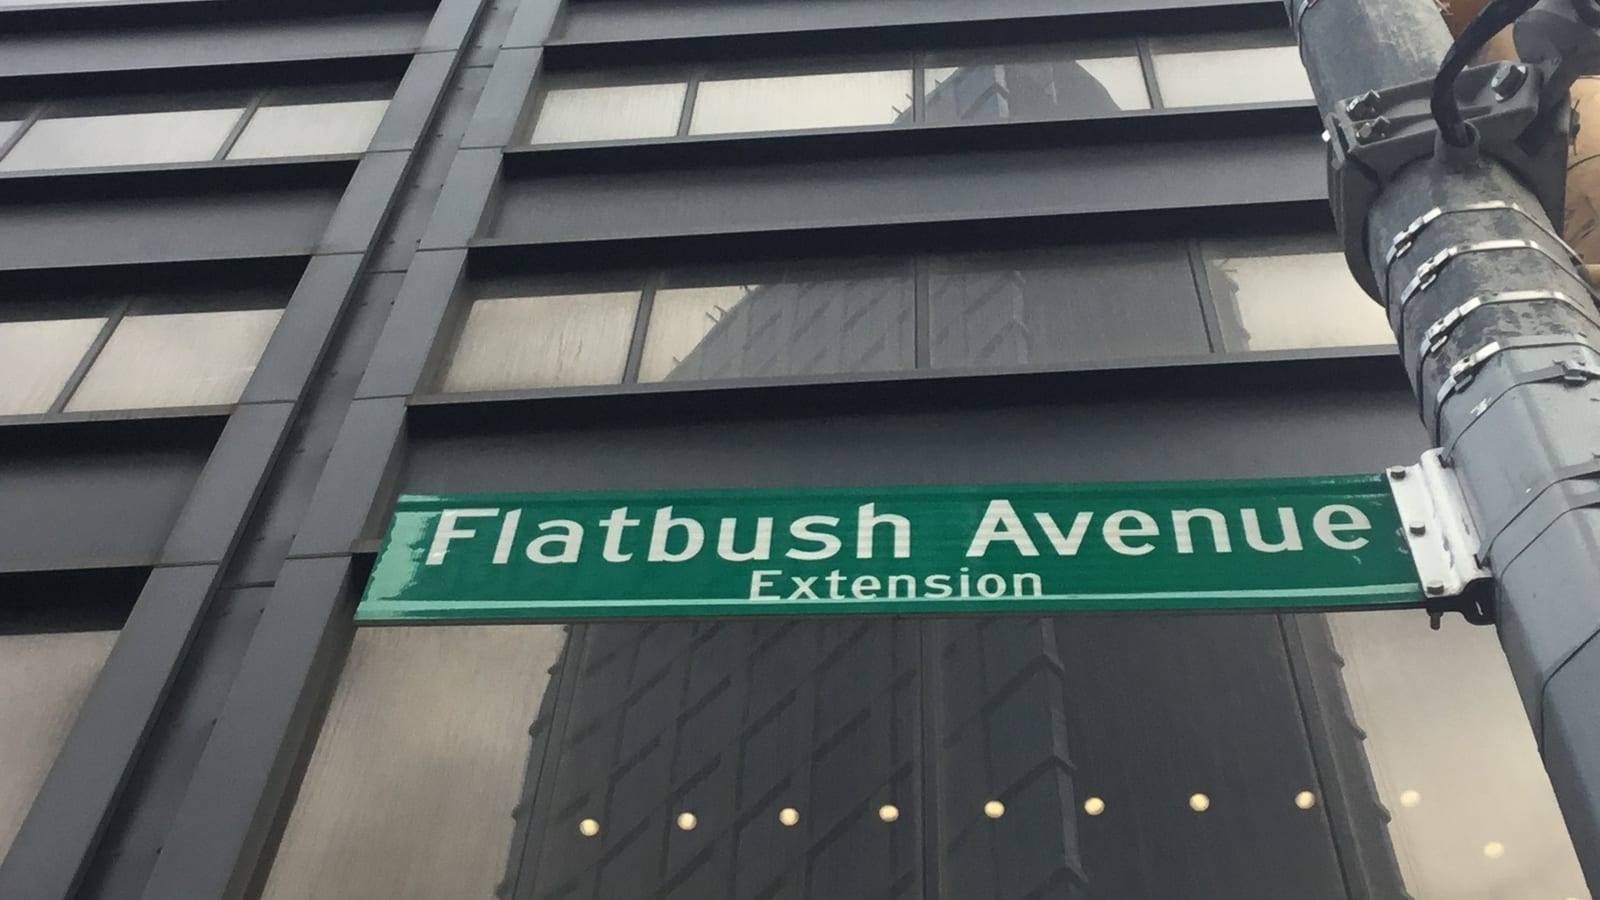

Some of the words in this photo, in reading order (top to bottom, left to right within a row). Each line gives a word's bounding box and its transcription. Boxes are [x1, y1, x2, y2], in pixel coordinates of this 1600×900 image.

[425, 502, 911, 566] Flatbush
[966, 499, 1372, 557] Avenue
[748, 567, 1043, 602] Extension
